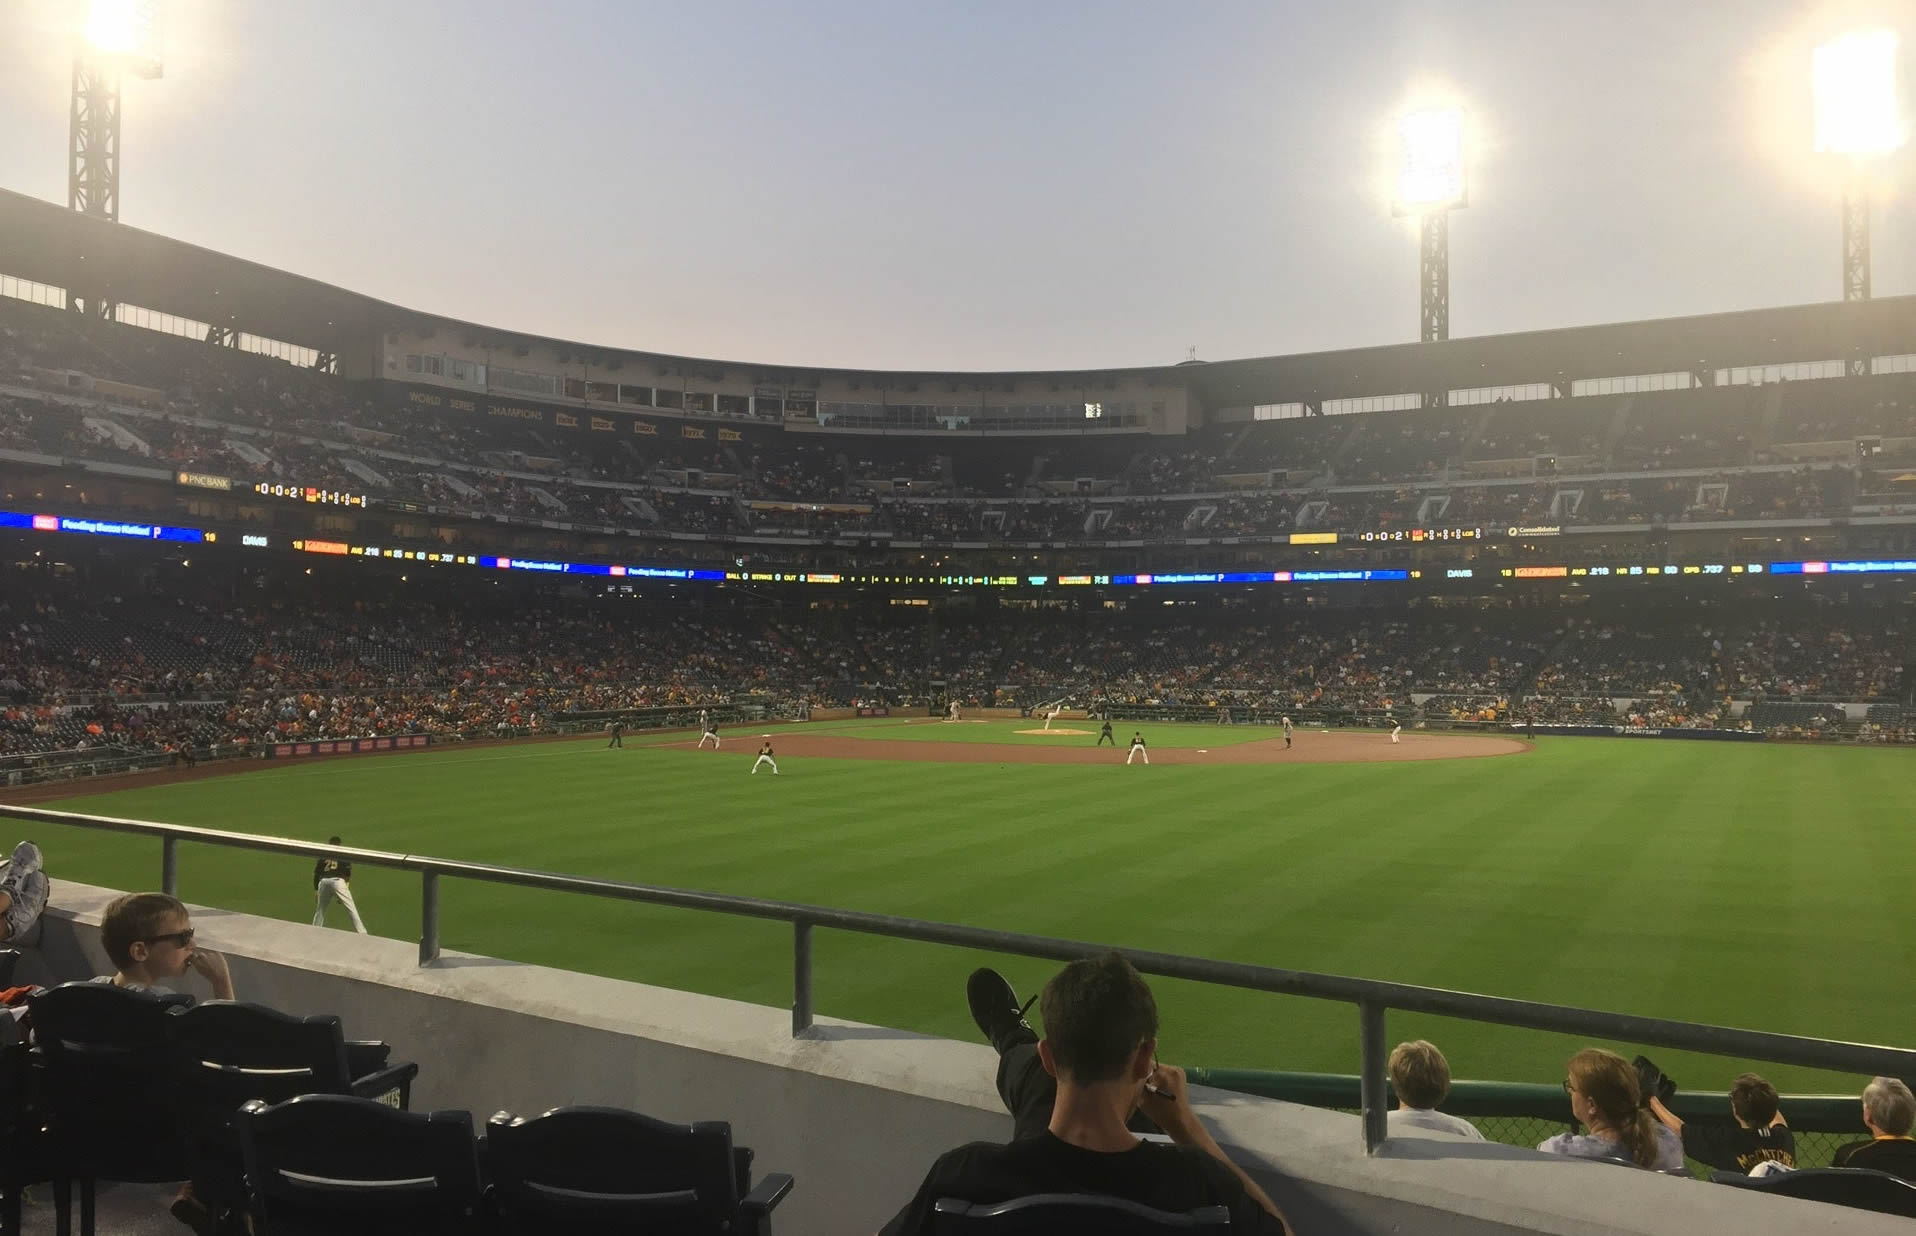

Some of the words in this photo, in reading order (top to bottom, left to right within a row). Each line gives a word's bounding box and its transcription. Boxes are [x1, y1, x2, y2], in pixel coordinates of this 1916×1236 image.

[487, 405, 543, 420] CHAMPIONS
[189, 473, 206, 485] PNC
[206, 476, 229, 488] BANK
[260, 482, 269, 494] 0
[275, 484, 283, 496] 0
[290, 487, 298, 498] 2
[1366, 531, 1374, 541] 0
[1380, 531, 1388, 541] 0
[1395, 531, 1403, 541] 2
[1447, 569, 1473, 578] DAVIS
[1571, 568, 1588, 576] AVG
[1616, 567, 1628, 575] HR
[1683, 566, 1700, 574] OPS
[726, 572, 741, 580] BALL
[742, 572, 749, 580] 0
[751, 573, 773, 581] STRIKE
[774, 573, 782, 581] 0
